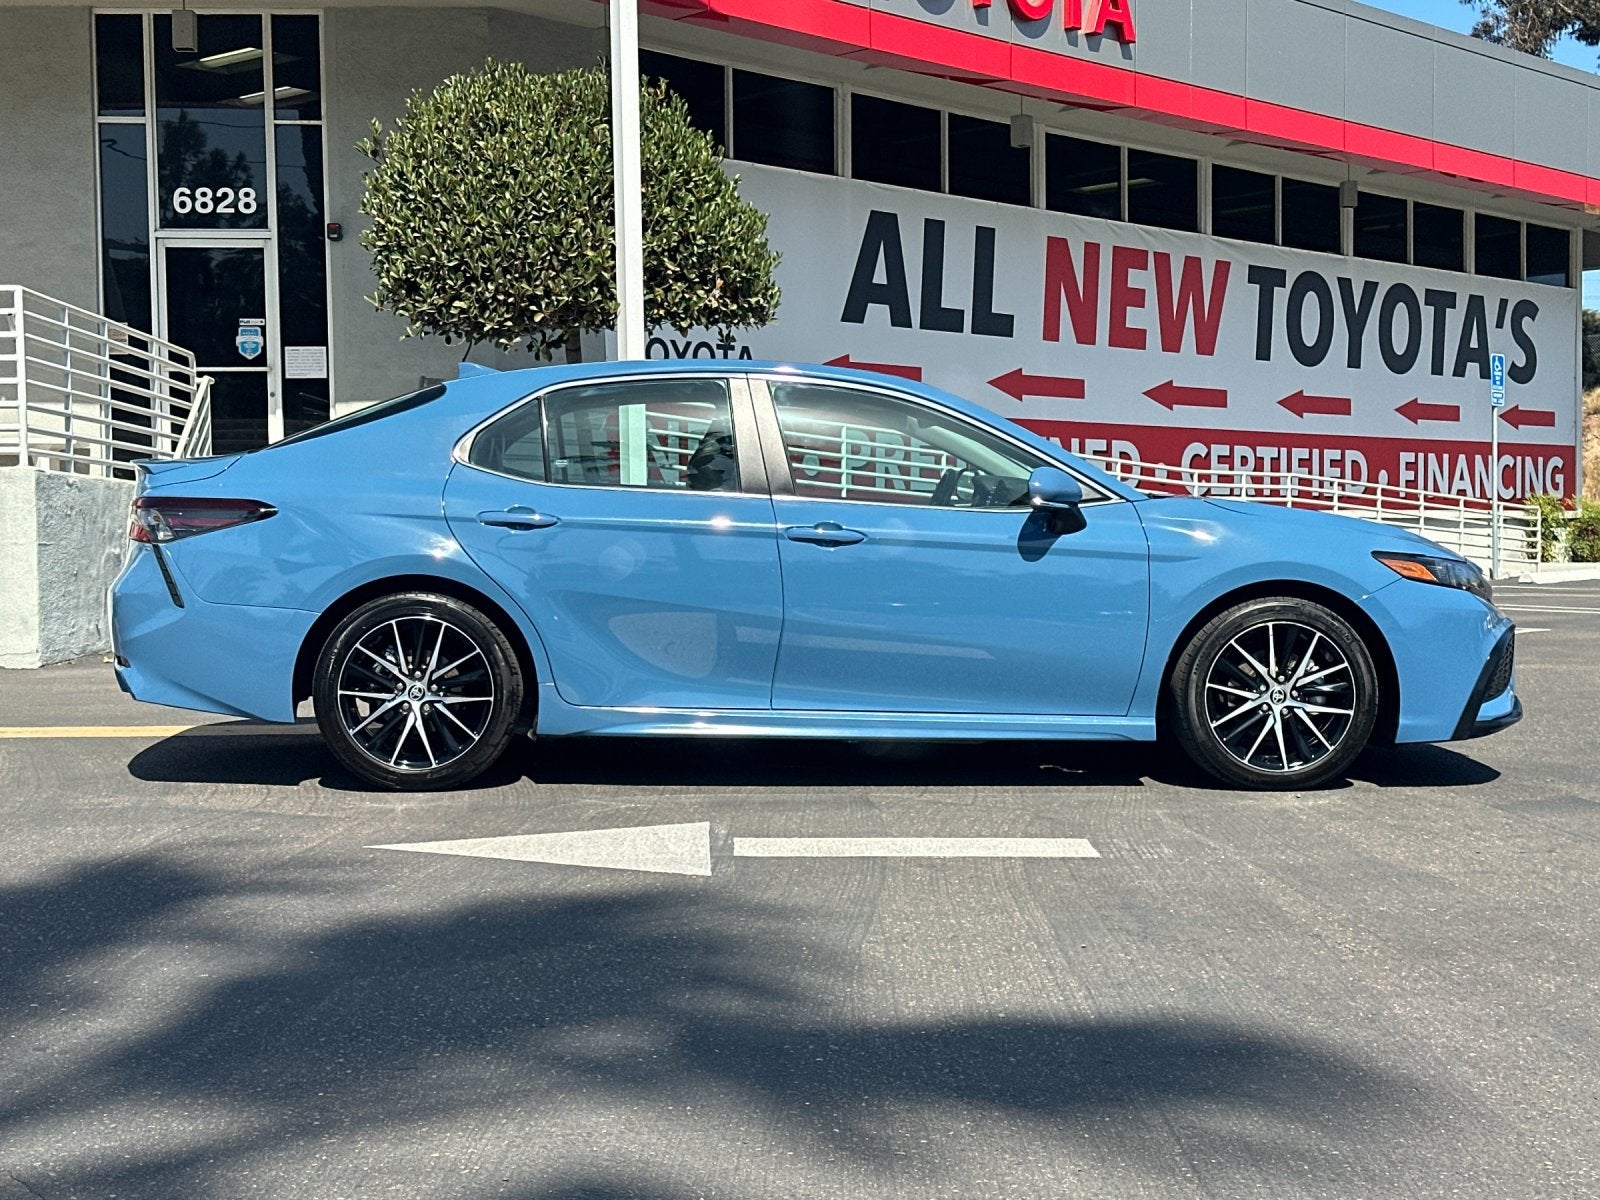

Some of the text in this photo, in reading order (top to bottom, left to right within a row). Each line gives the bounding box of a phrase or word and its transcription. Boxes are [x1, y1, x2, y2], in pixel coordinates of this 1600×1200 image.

[173, 187, 257, 214] 6828
[841, 209, 1539, 385] ALL NEW TOYOTA'S
[645, 337, 753, 360] OYOTA
[1181, 442, 1368, 497] CERTIFIED
[1399, 451, 1564, 500] FINANCING
